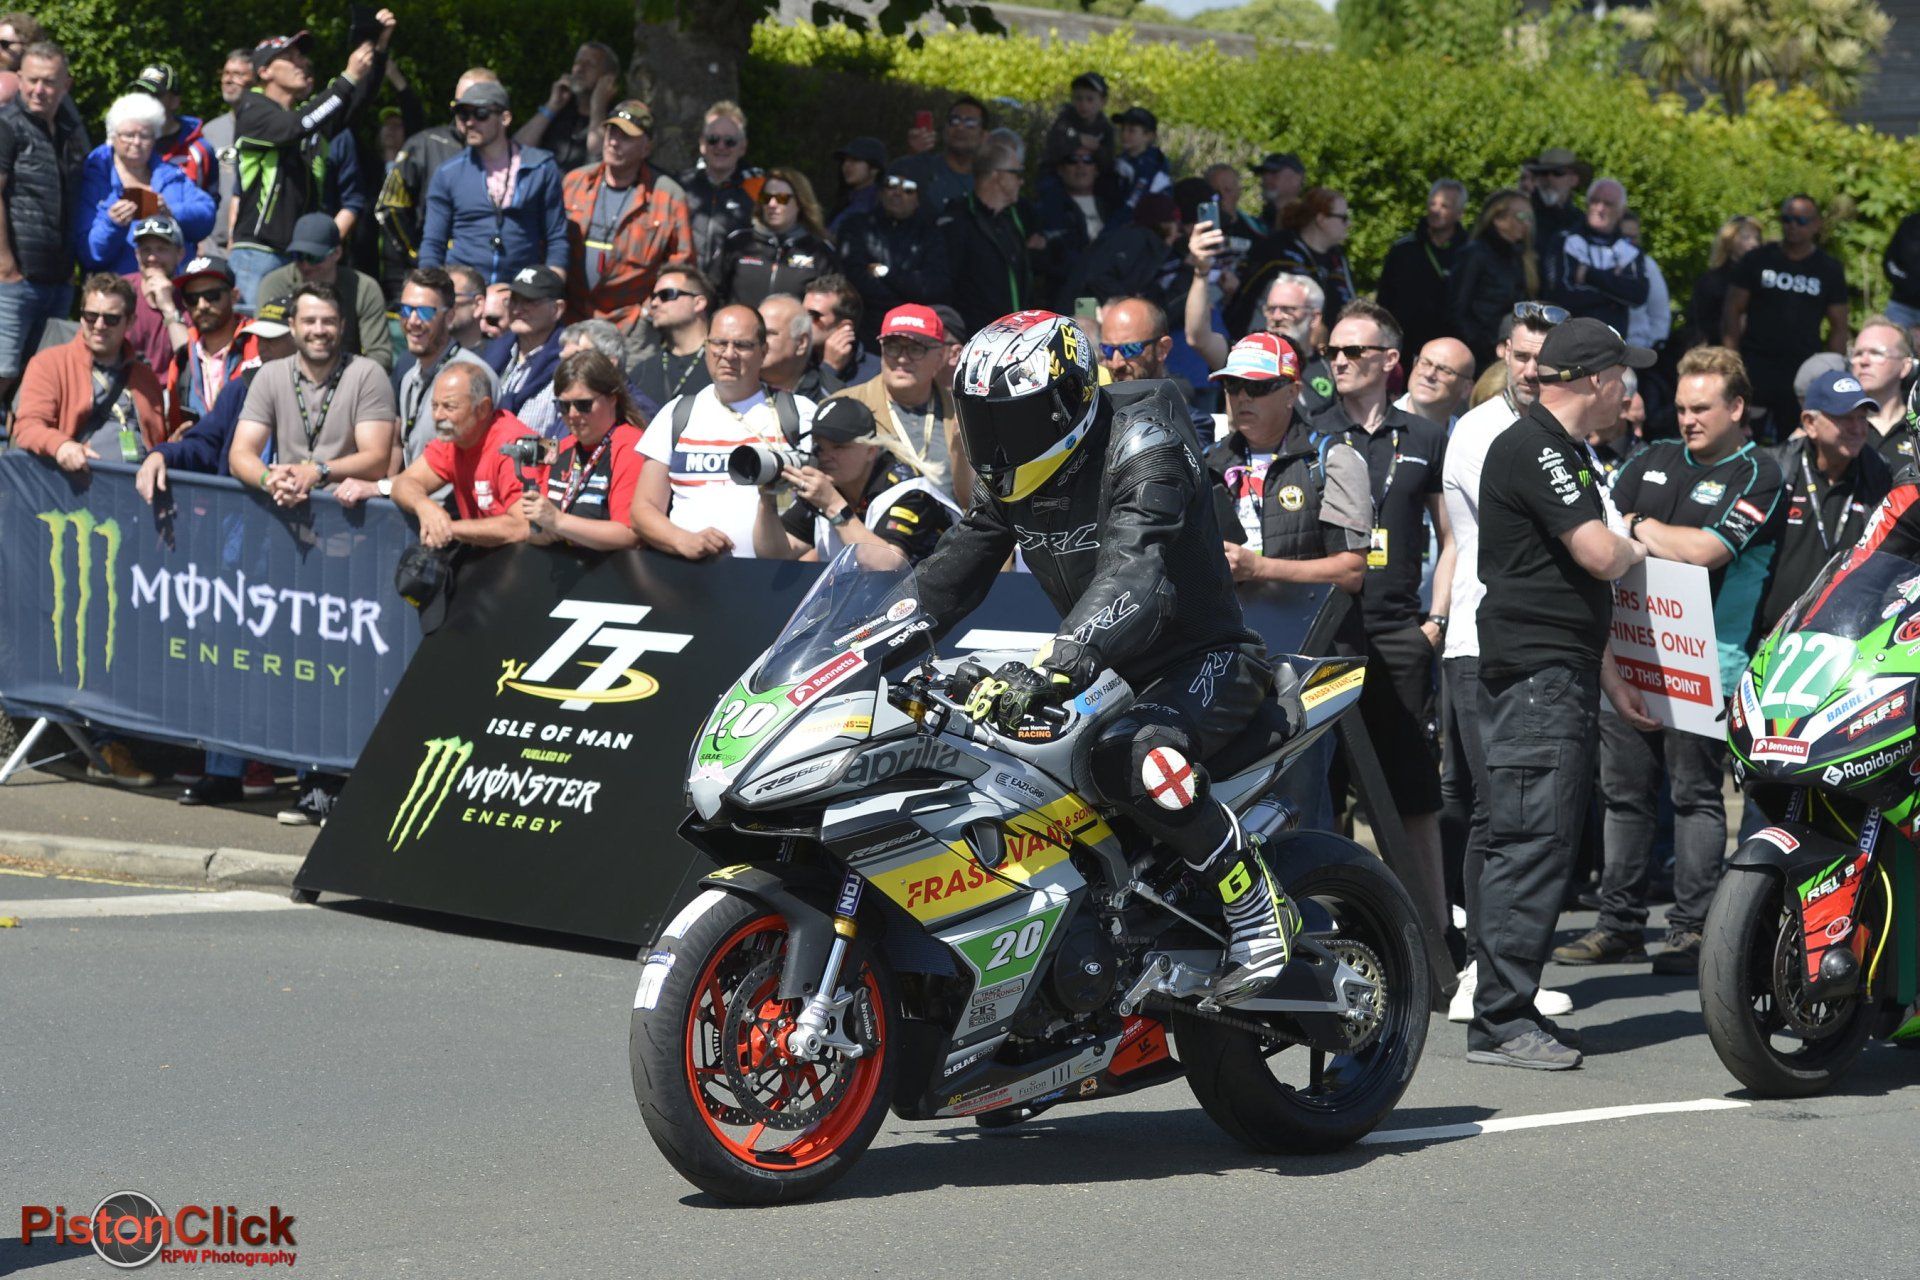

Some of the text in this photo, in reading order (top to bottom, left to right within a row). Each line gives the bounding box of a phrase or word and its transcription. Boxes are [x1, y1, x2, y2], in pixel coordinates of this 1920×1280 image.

[1761, 268, 1821, 296] BOSS
[1645, 594, 1684, 620] AND
[887, 620, 930, 647] aprilia
[1661, 631, 1706, 658] ONLY
[169, 637, 346, 686] ENERGY
[519, 599, 695, 713] TT
[1761, 632, 1836, 708] 22
[812, 657, 856, 688] Bennetts
[1635, 668, 1662, 686] THIS
[1664, 674, 1702, 696] POINT
[1084, 688, 1104, 706] OXON
[705, 698, 780, 740] 20
[486, 718, 634, 750] ISLE OF MAN
[1768, 741, 1805, 754] Bennetts
[520, 748, 573, 764] FUELLED BY
[842, 734, 961, 785] aprilia
[755, 759, 834, 796] RS660
[461, 807, 562, 834] ENERGY
[1064, 815, 1072, 828] &
[984, 919, 1045, 972] 20
[861, 1002, 873, 1040] brembo
